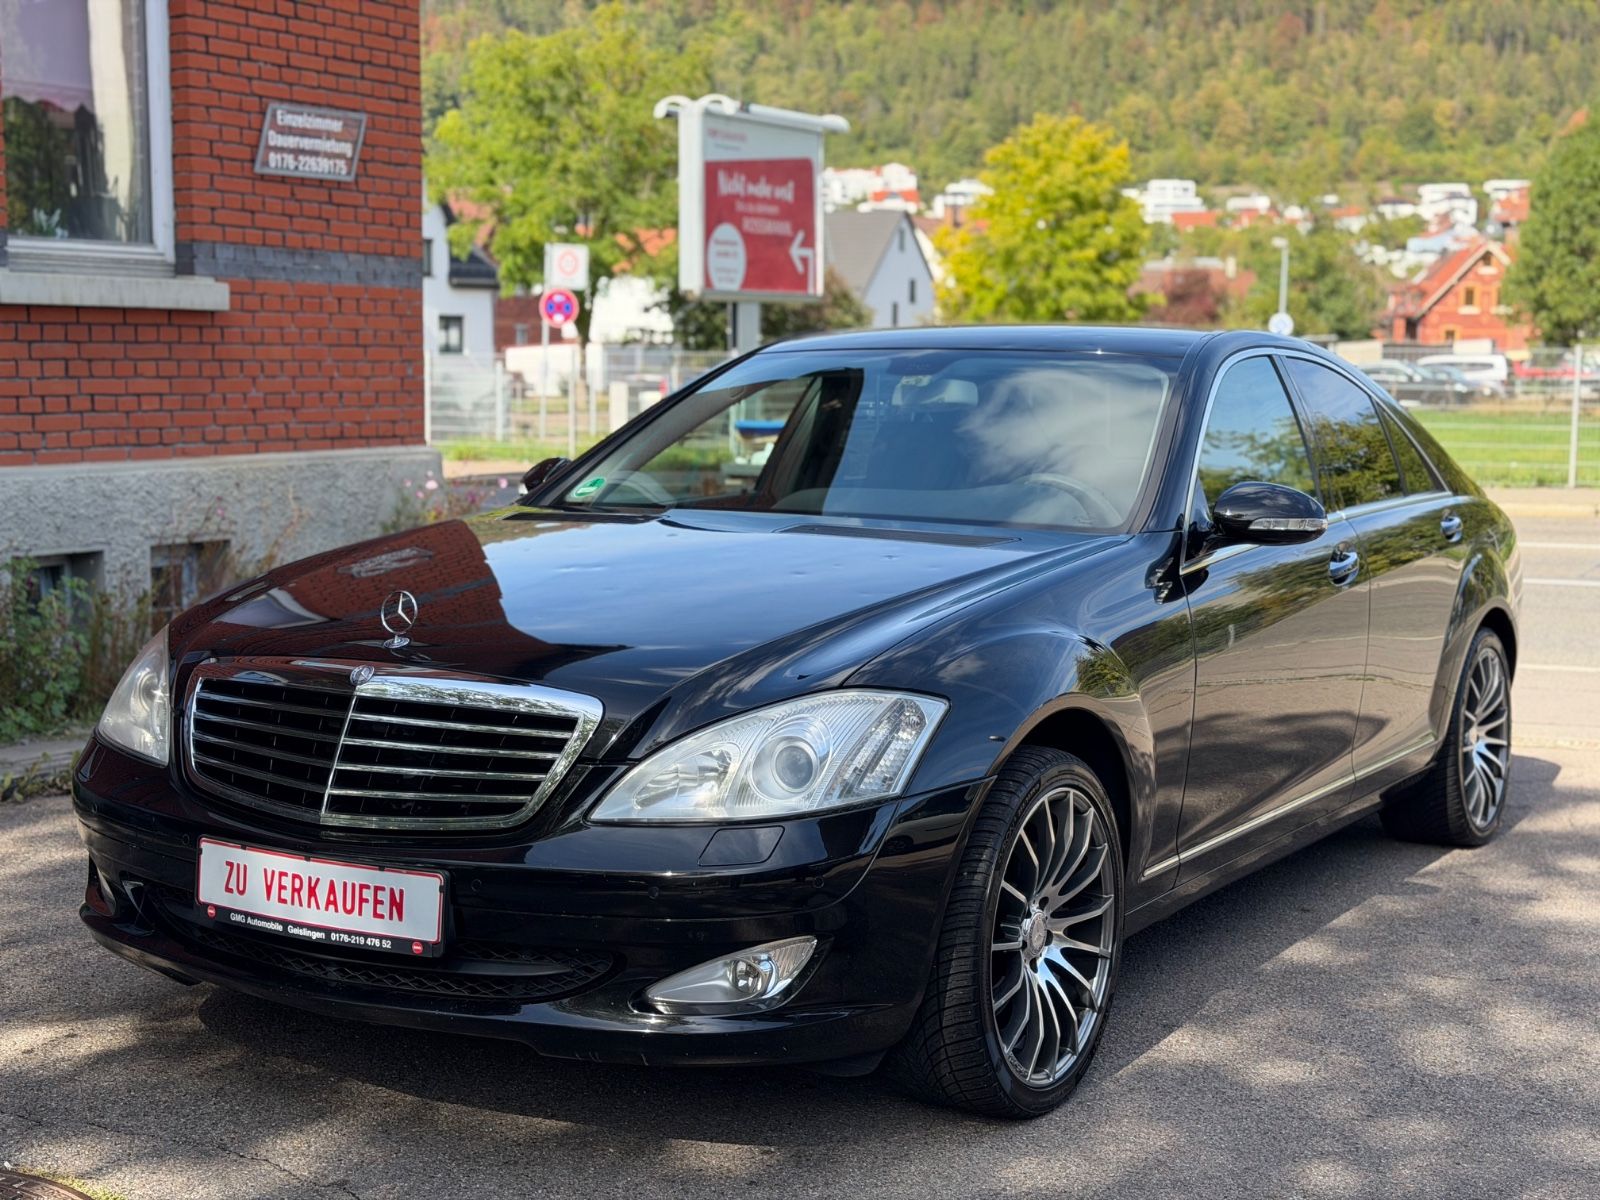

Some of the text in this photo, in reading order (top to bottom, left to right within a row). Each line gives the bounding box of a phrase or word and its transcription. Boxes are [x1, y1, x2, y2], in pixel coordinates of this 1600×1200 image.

[267, 130, 353, 158] Dauervermietung
[224, 860, 405, 922] ZU VERKAUFEN
[230, 912, 392, 949] GMG Automobile Geislingen 0176-219 476 52
